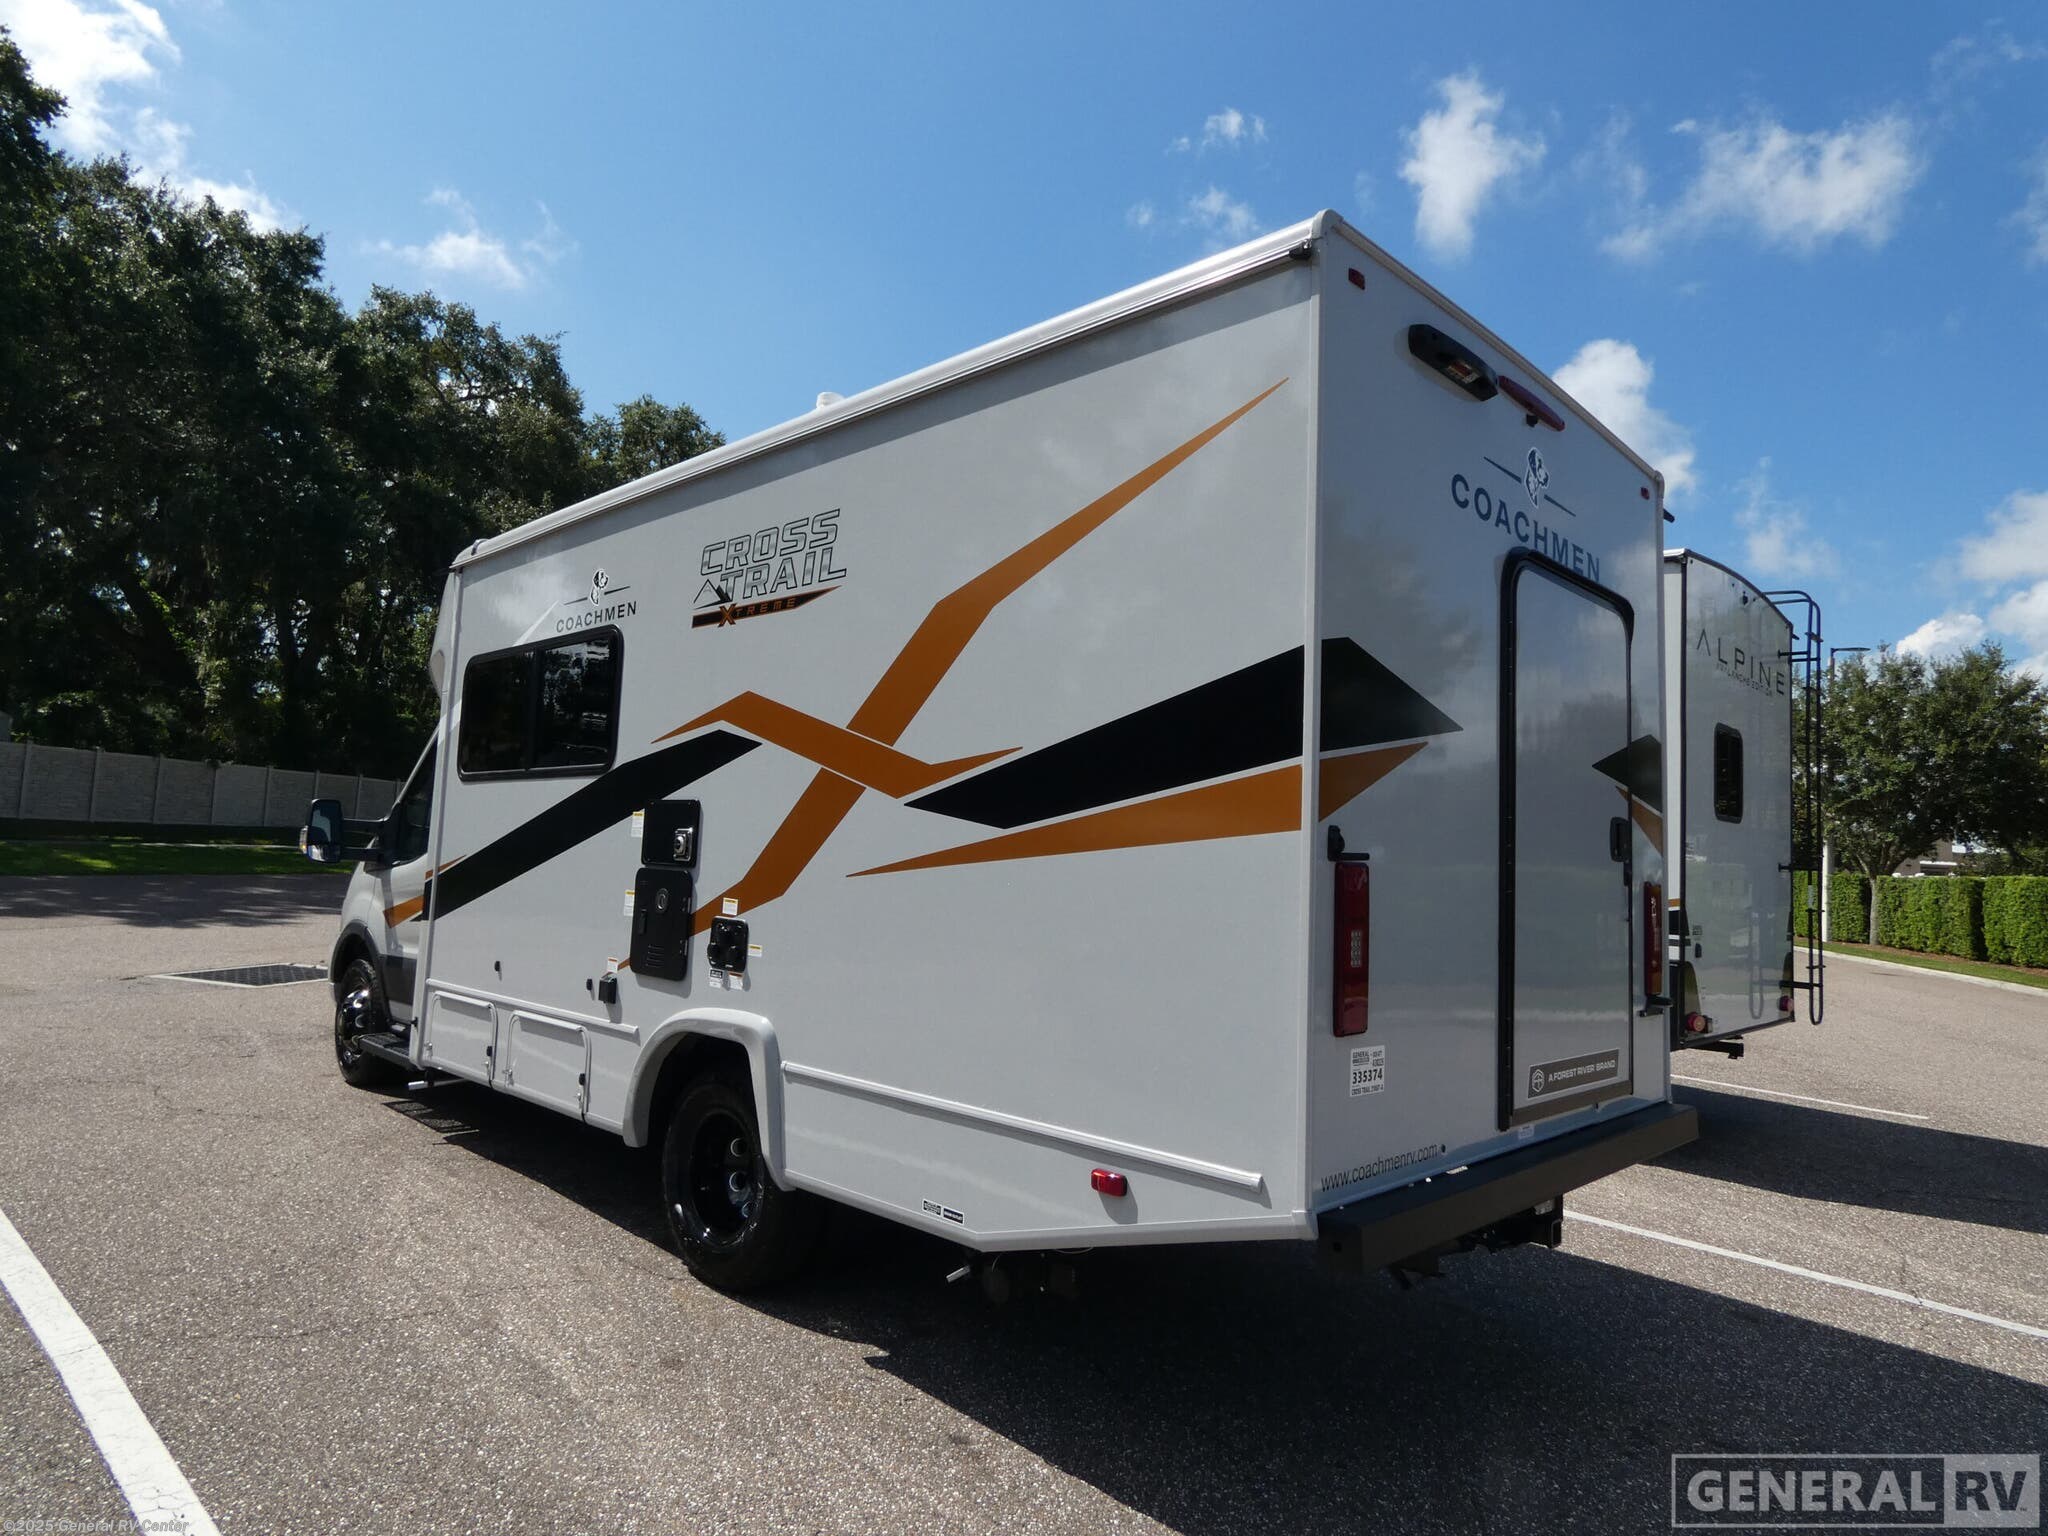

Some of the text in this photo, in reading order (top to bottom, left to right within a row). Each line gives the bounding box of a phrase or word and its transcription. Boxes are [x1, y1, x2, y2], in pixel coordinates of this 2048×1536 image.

[700, 508, 841, 576] CROSS
[1450, 473, 1600, 583] COACHMEN
[719, 547, 848, 603] TRAIL
[556, 600, 637, 633] COACHMEN
[717, 597, 797, 628] XTREME
[1696, 628, 1785, 696] ALPINE
[1352, 1068, 1383, 1085] 335374
[1553, 1068, 1577, 1080] FOREST
[1577, 1064, 1595, 1075] RIVER
[1596, 1060, 1616, 1072] BRAND
[1320, 1143, 1439, 1193] www.coachmenrv.com
